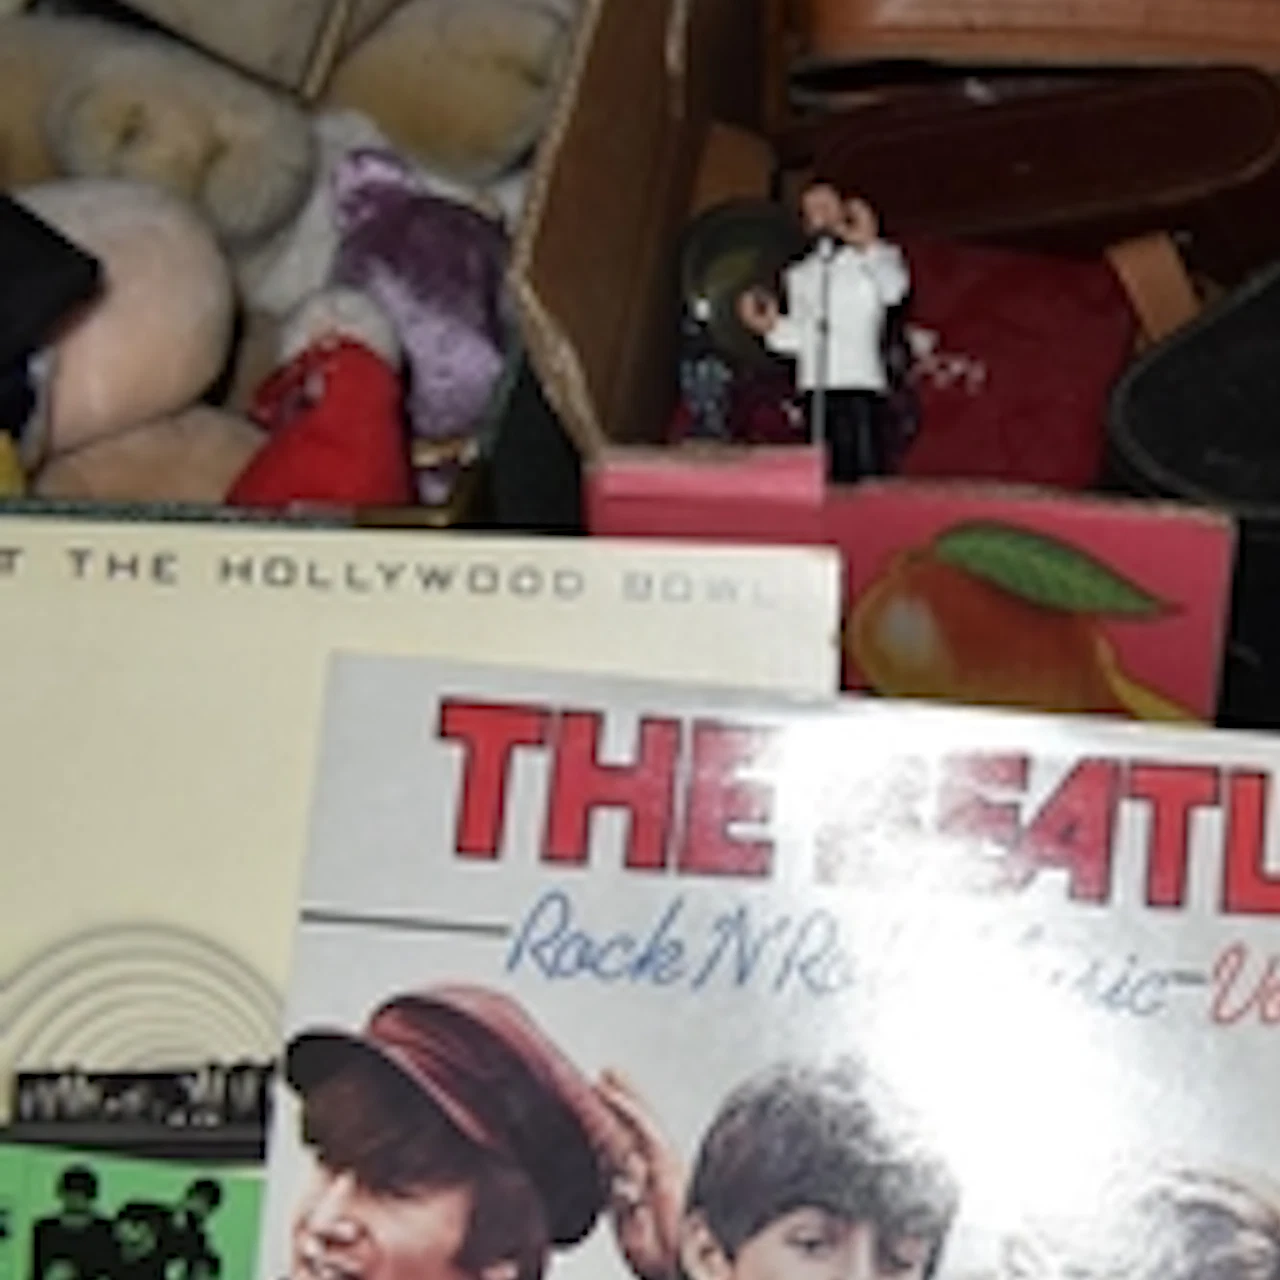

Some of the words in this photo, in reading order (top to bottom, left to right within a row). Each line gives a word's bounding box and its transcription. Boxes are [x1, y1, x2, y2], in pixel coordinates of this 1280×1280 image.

[66, 547, 180, 587] THE
[218, 552, 586, 600] HOLLYWOOD
[621, 570, 778, 610] BOWL
[435, 696, 784, 880] THE
[506, 888, 686, 987] Rock
